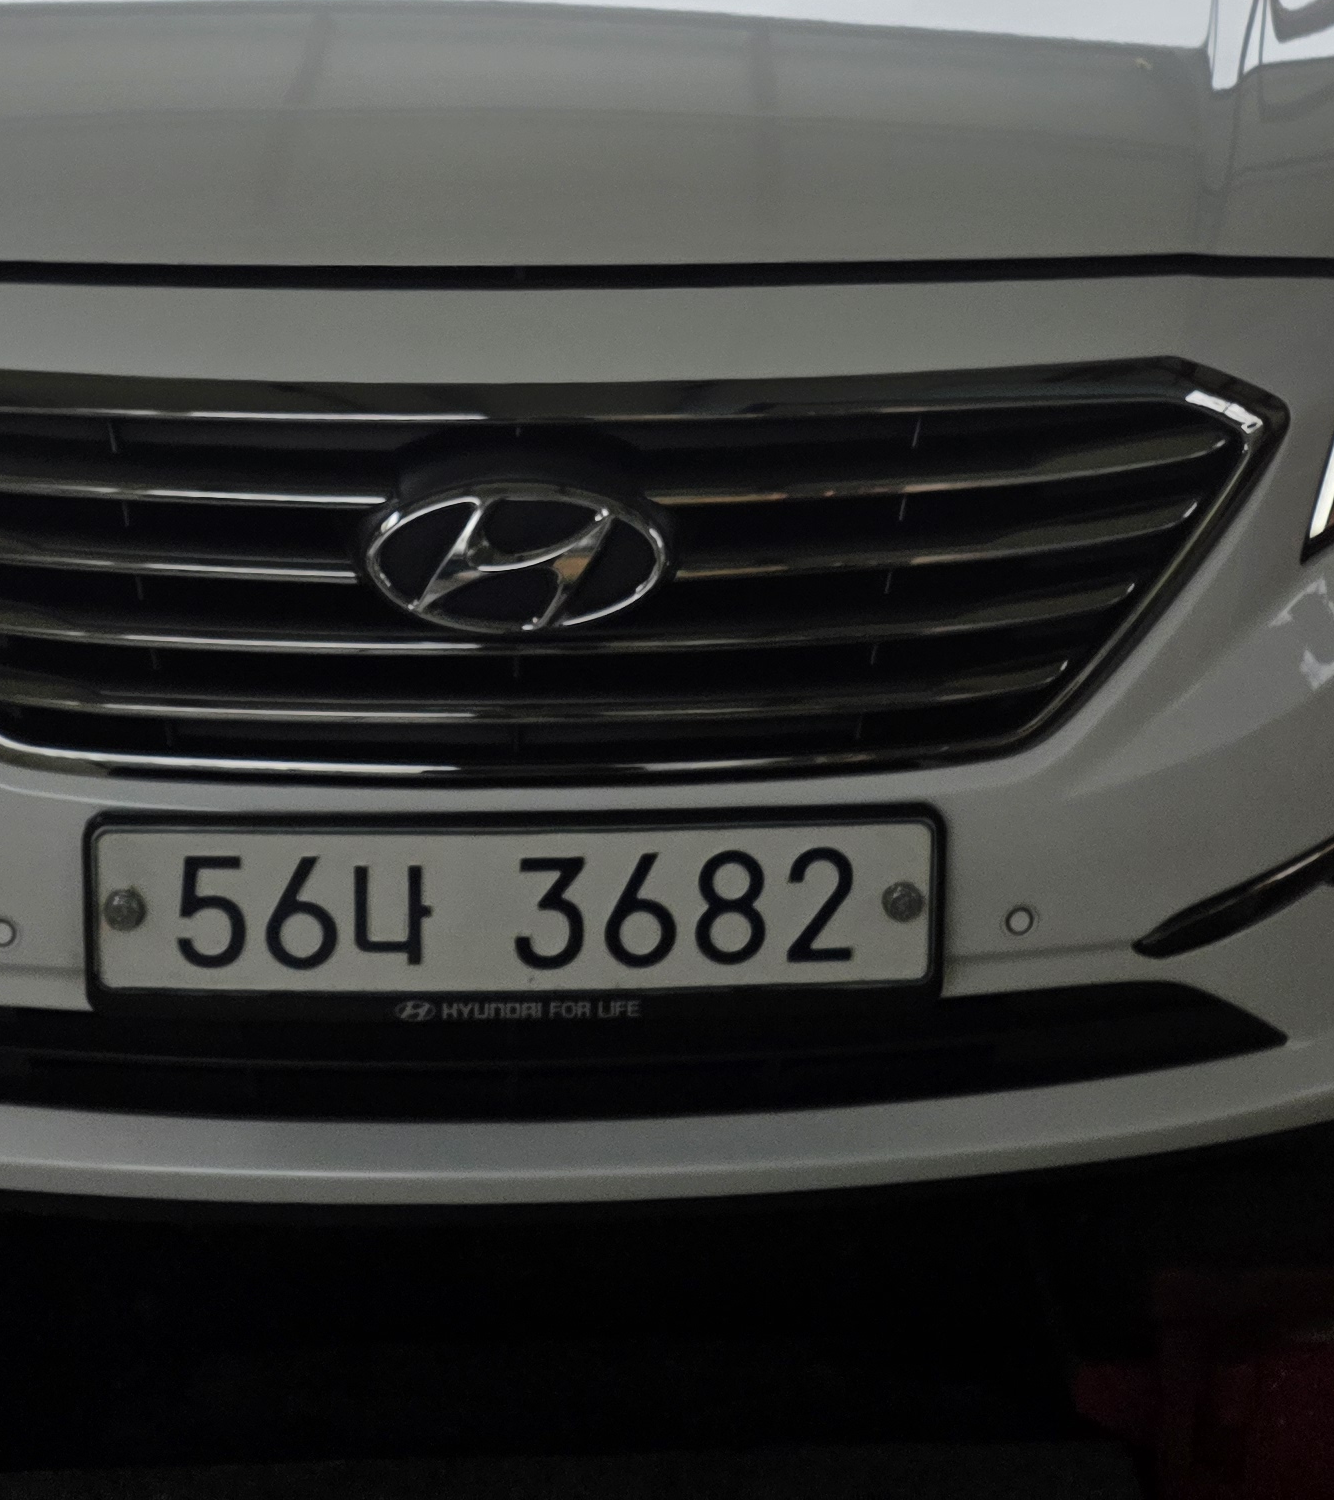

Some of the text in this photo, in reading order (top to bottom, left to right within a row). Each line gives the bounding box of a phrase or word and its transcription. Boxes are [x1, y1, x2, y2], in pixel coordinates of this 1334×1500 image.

[175, 846, 855, 970] 56나 3682
[441, 997, 640, 1019] HYUNDAI FOR LIFE
